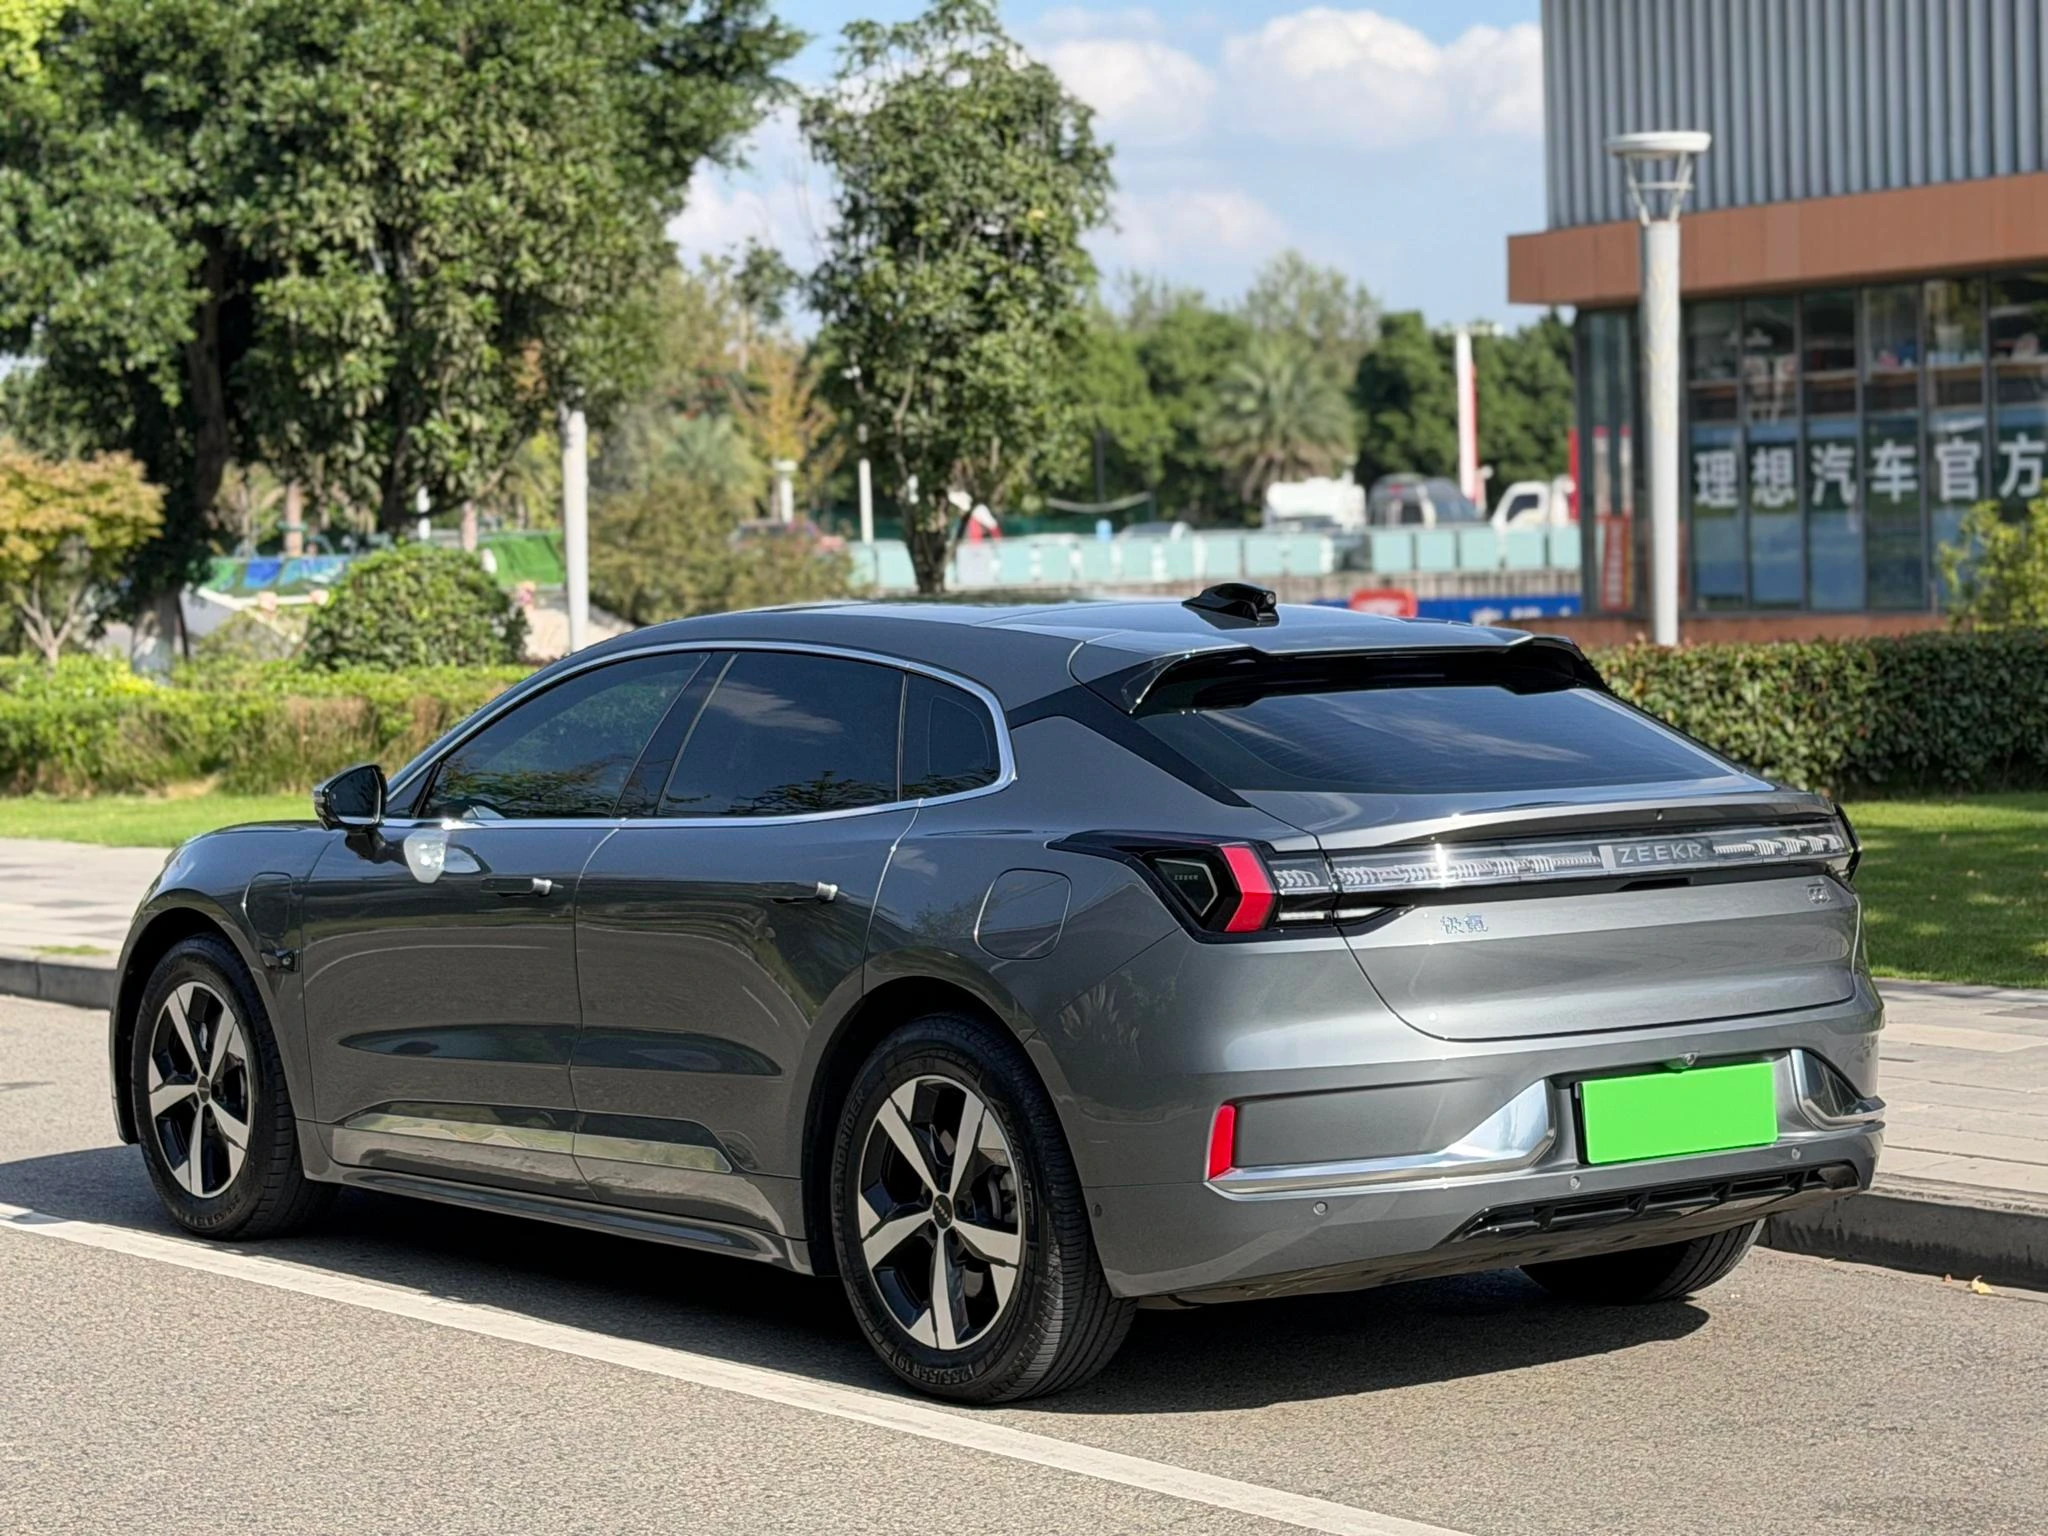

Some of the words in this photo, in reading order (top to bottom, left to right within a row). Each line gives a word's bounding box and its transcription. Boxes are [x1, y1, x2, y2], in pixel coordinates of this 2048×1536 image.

[1695, 433, 2046, 507] 理想汽车官方
[1617, 841, 1704, 865] ZEEKR
